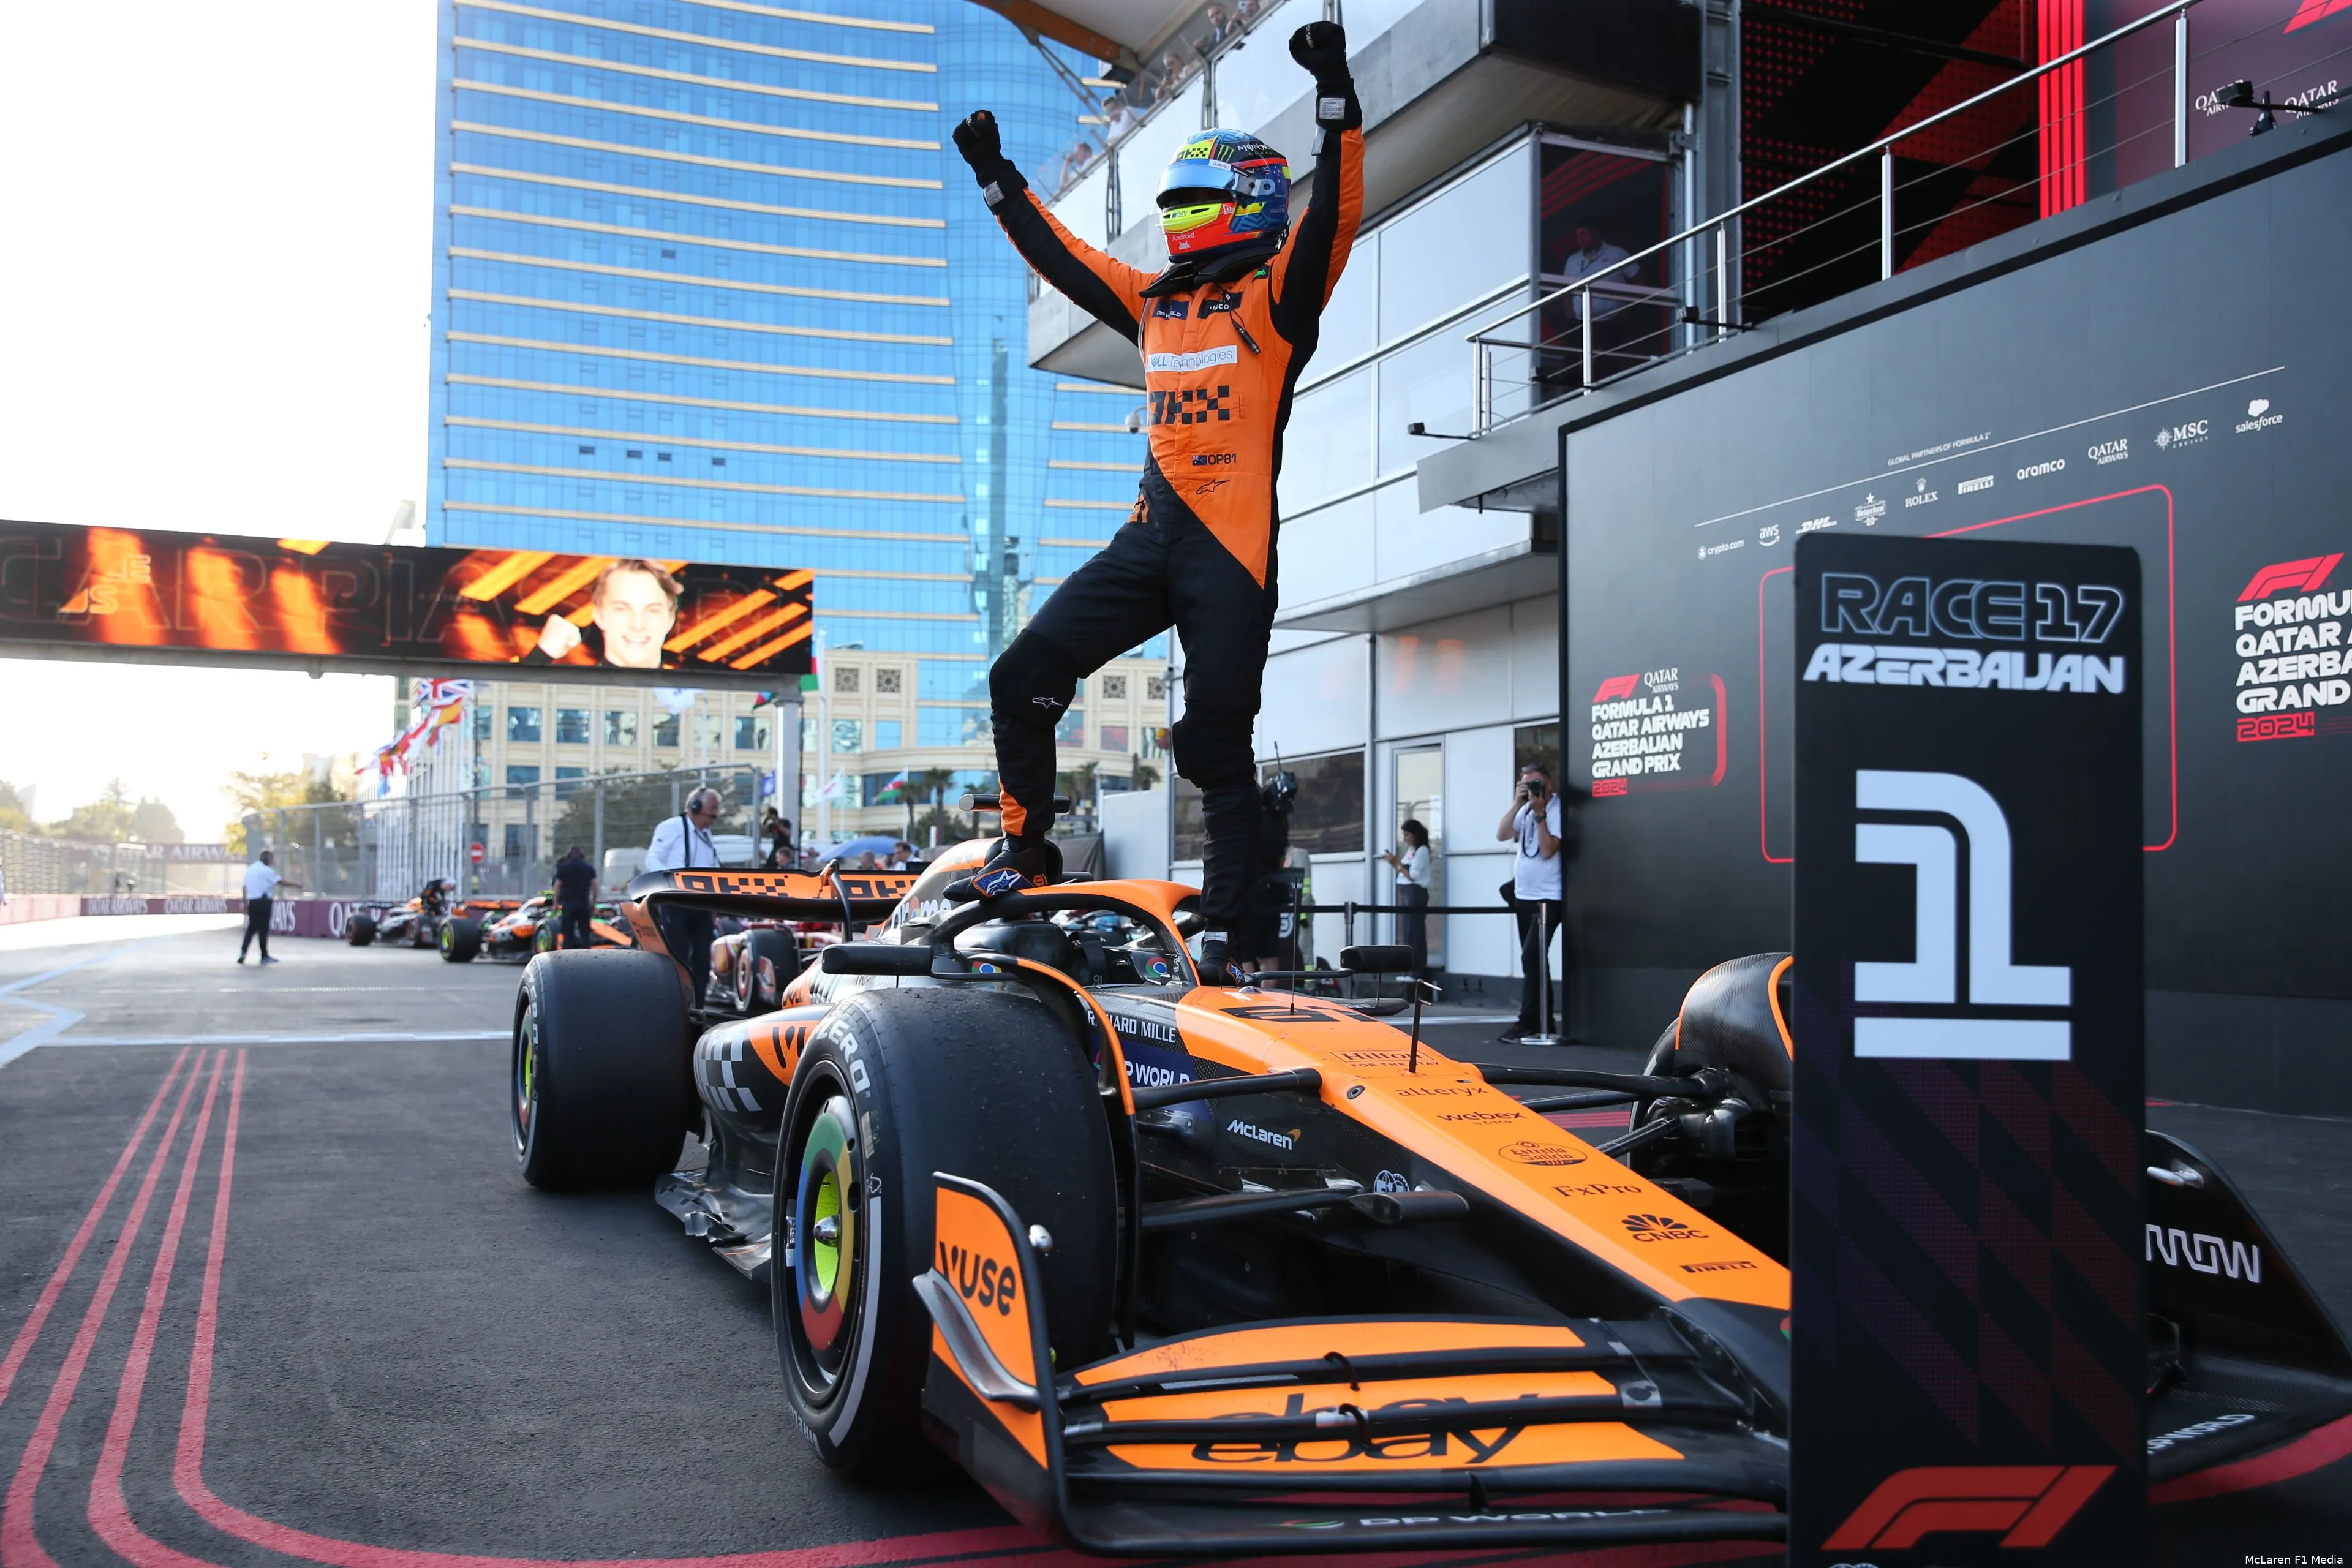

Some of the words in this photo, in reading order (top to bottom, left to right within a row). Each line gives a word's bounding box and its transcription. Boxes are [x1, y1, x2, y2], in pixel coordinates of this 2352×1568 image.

[1172, 230, 1195, 241] Android
[2173, 420, 2209, 442] MSC
[2234, 413, 2283, 434] salesforce
[1208, 453, 1237, 465] OP81
[1888, 453, 1911, 466] GLOBAL
[1911, 444, 1943, 460] PARTNERS
[1943, 442, 1952, 451] OF
[1953, 434, 1984, 448] FORMULA
[2087, 438, 2128, 460] QATAR
[2097, 450, 2129, 466] AIRWAYS
[2016, 458, 2065, 480] aramco
[1958, 475, 1994, 495] PIRELLI
[1905, 490, 1939, 508] ROLEX
[1759, 524, 1779, 539] aws
[1801, 516, 1831, 533] DHL
[1707, 539, 1745, 556] crypto.com
[1821, 571, 2025, 641] RACE
[2035, 583, 2123, 643] 17
[2235, 589, 2352, 631] FORMU
[2236, 620, 2342, 658] QATAR
[1644, 667, 1679, 688] QATAR
[1803, 643, 2125, 694] AZERBAIJAN
[1651, 681, 1679, 694] AIRWAYS
[2236, 679, 2351, 714] GRAND
[1591, 695, 1664, 722] FORMULA
[1664, 693, 1675, 712] 1
[1591, 718, 1640, 741] QATAR
[1640, 708, 1711, 735] AIRWAYS
[2237, 712, 2315, 742] 2024
[1591, 732, 1684, 760] AZERBAIJAN
[1591, 756, 1643, 778] GRAND
[1644, 752, 1681, 774] PRIX
[1855, 769, 2072, 1060] 1
[1140, 1021, 1177, 1043] MILLE
[1398, 1086, 1490, 1096] alteryx
[1437, 1110, 1527, 1122] webex
[1227, 1120, 1294, 1150] McLaren
[1550, 1183, 1642, 1197] FxPro
[1632, 1229, 1710, 1242] CNBC
[1679, 1261, 1758, 1273] PIRELLI
[1191, 1392, 1540, 1464] ebay
[1359, 1517, 1440, 1526] DP
